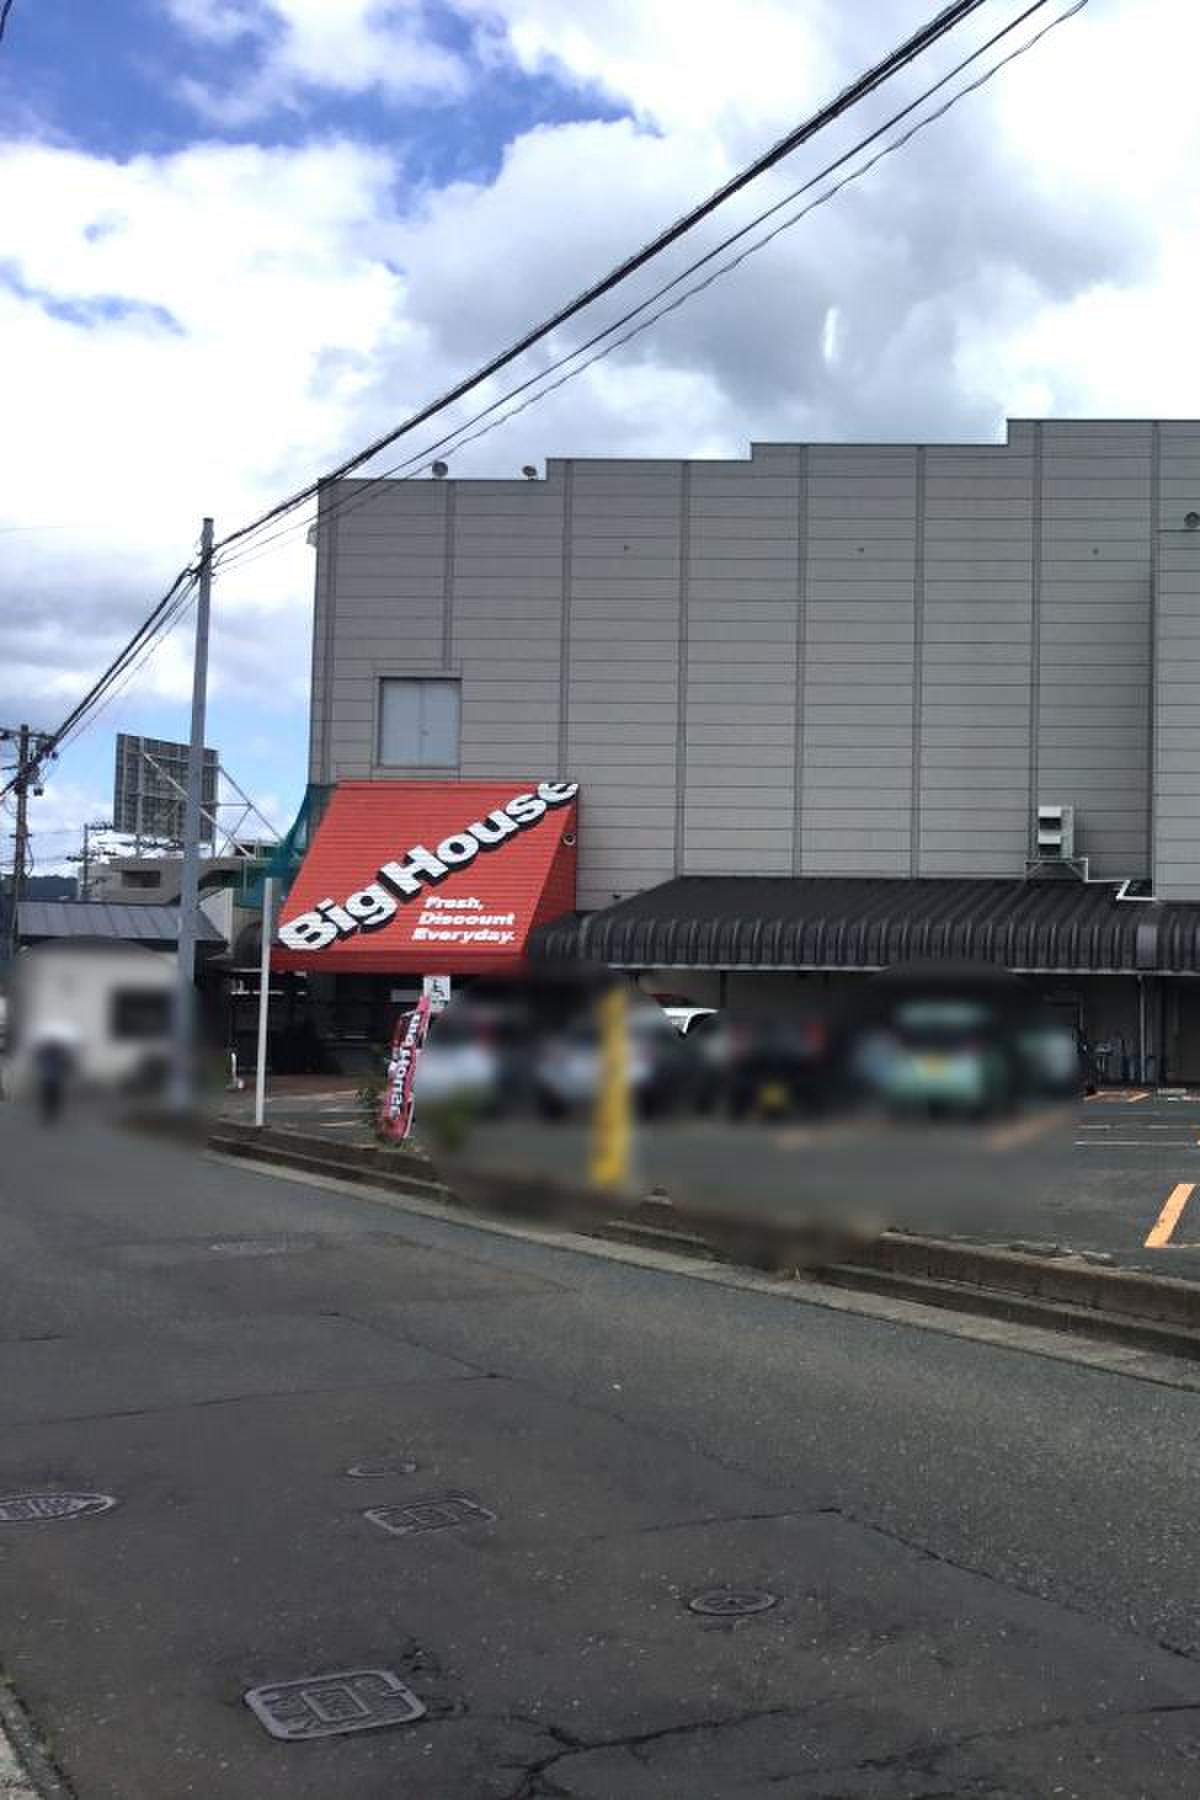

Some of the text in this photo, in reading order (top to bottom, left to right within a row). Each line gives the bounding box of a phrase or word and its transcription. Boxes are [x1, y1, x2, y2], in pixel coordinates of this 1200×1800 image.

[277, 782, 579, 951] Big House
[424, 896, 484, 911] Fresh,
[417, 911, 516, 926] Discount
[411, 928, 515, 944] Everyday.
